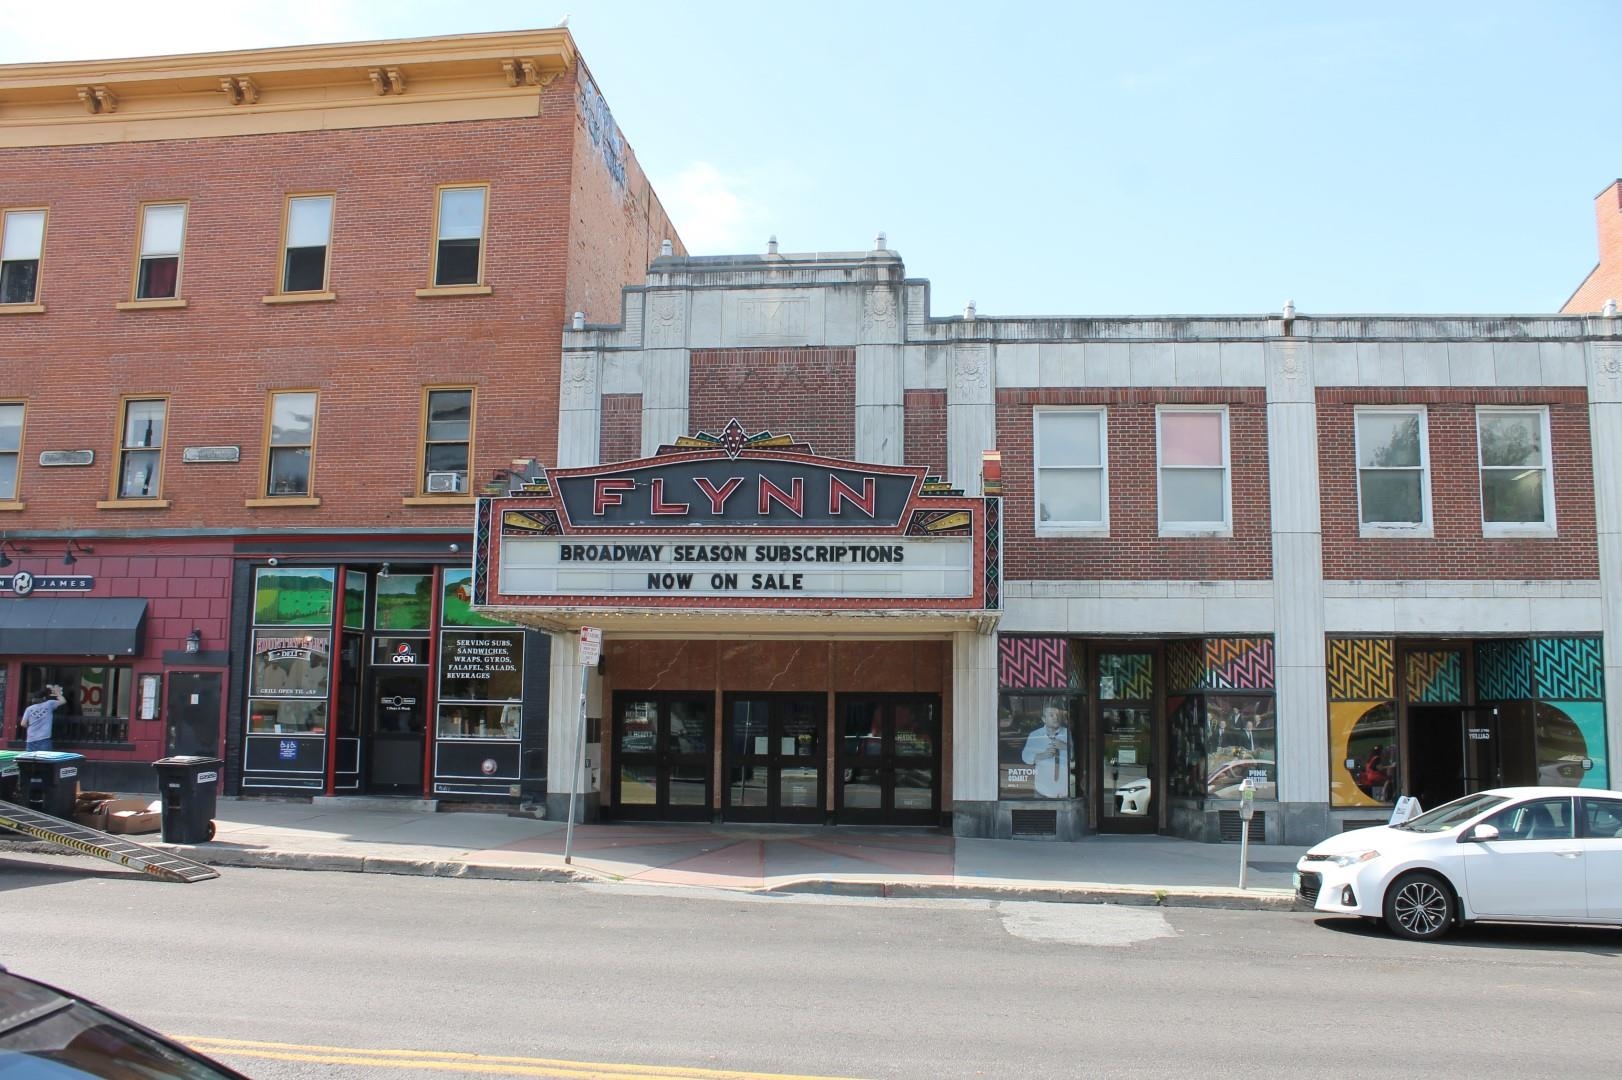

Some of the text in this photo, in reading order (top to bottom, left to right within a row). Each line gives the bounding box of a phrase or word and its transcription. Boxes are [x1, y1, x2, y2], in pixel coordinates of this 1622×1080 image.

[593, 474, 876, 518] FLYNN
[560, 545, 904, 563] BROADWAY SEASON SUBSCRIPTIONS
[647, 573, 804, 590] NOW ON SALE
[392, 655, 414, 663] OPEN
[1008, 768, 1038, 776] PATTON
[1248, 769, 1268, 777] PINK
